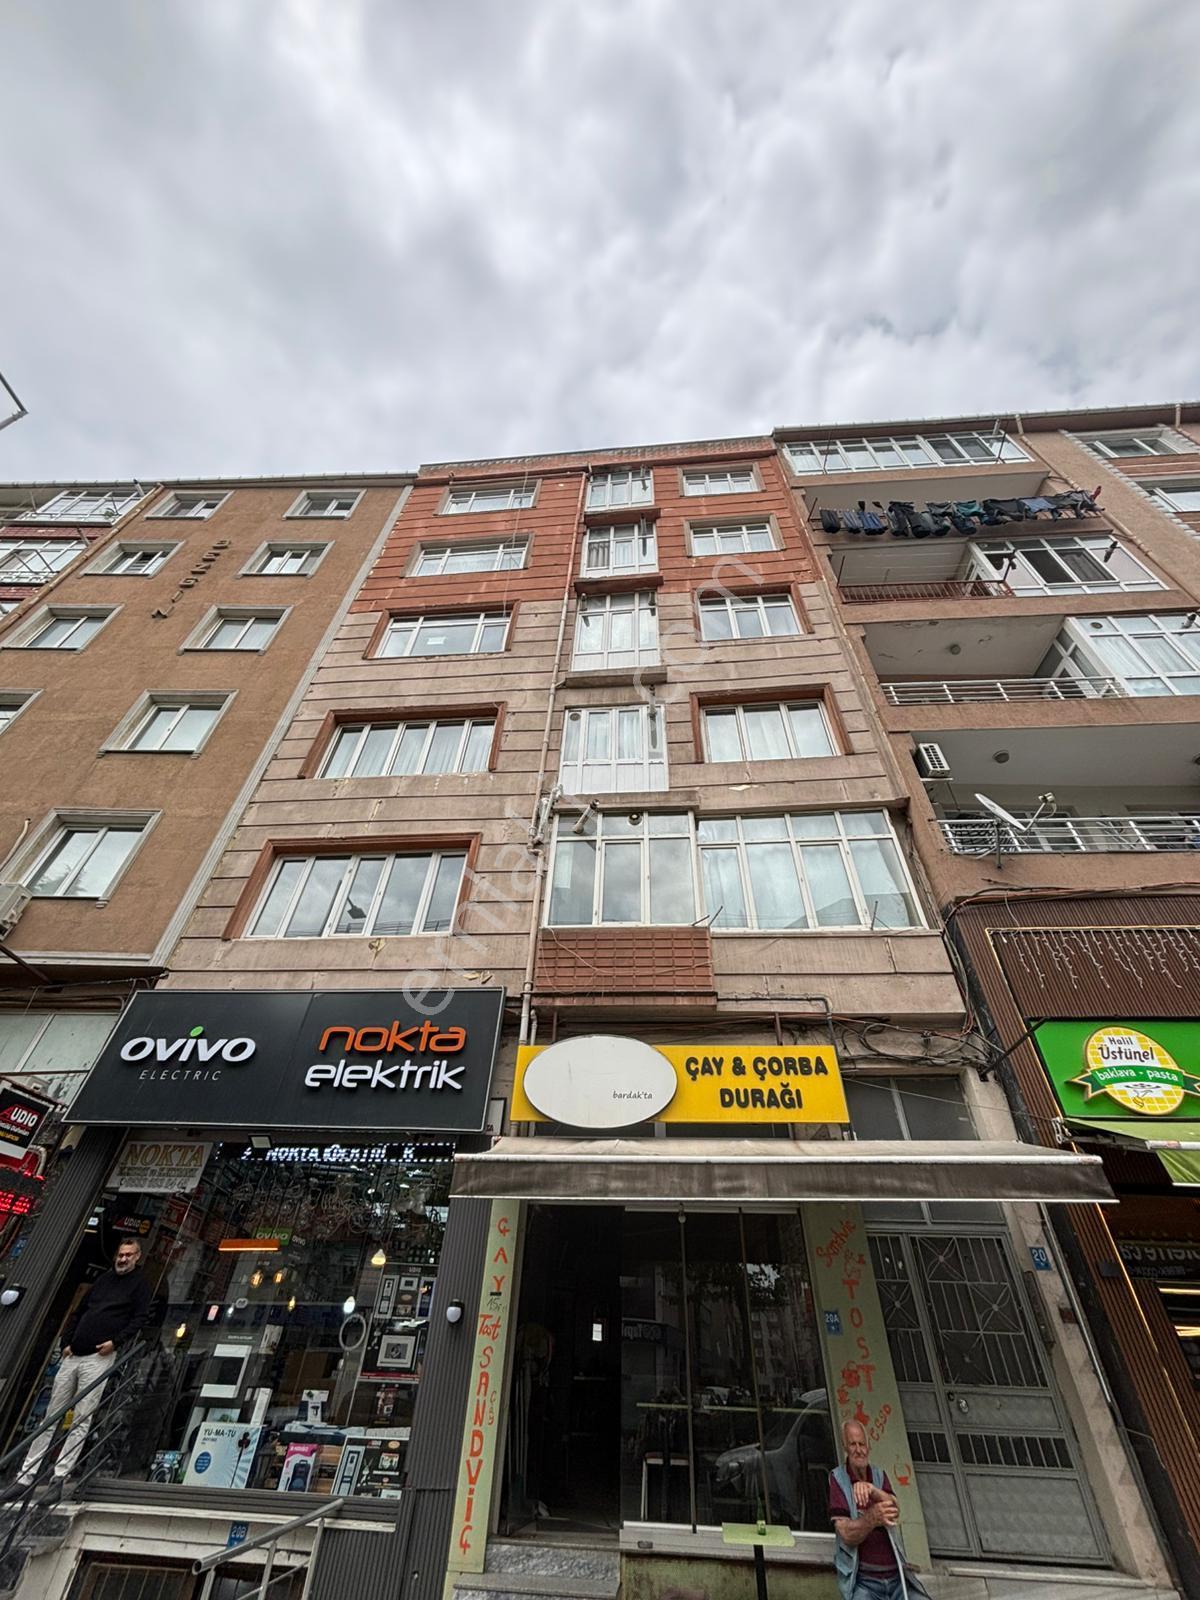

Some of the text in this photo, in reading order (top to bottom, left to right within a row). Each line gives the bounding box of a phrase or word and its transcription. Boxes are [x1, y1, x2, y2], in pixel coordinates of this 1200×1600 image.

[120, 1026, 257, 1062] ovivo
[319, 1020, 467, 1053] nokta
[1108, 1037, 1133, 1045] Halil
[1098, 1045, 1155, 1062] Üstünel
[139, 1069, 222, 1081] ELECTRIC
[304, 1060, 466, 1090] elektrik
[685, 1056, 829, 1081] ÇAY & ÇORBA
[1096, 1068, 1136, 1081] baklava
[1147, 1070, 1179, 1081] pasta
[612, 1090, 653, 1100] bardak'ta
[720, 1082, 803, 1109] DURAĞI
[123, 1144, 206, 1167] NOKTA
[1032, 1249, 1047, 1262] 20
